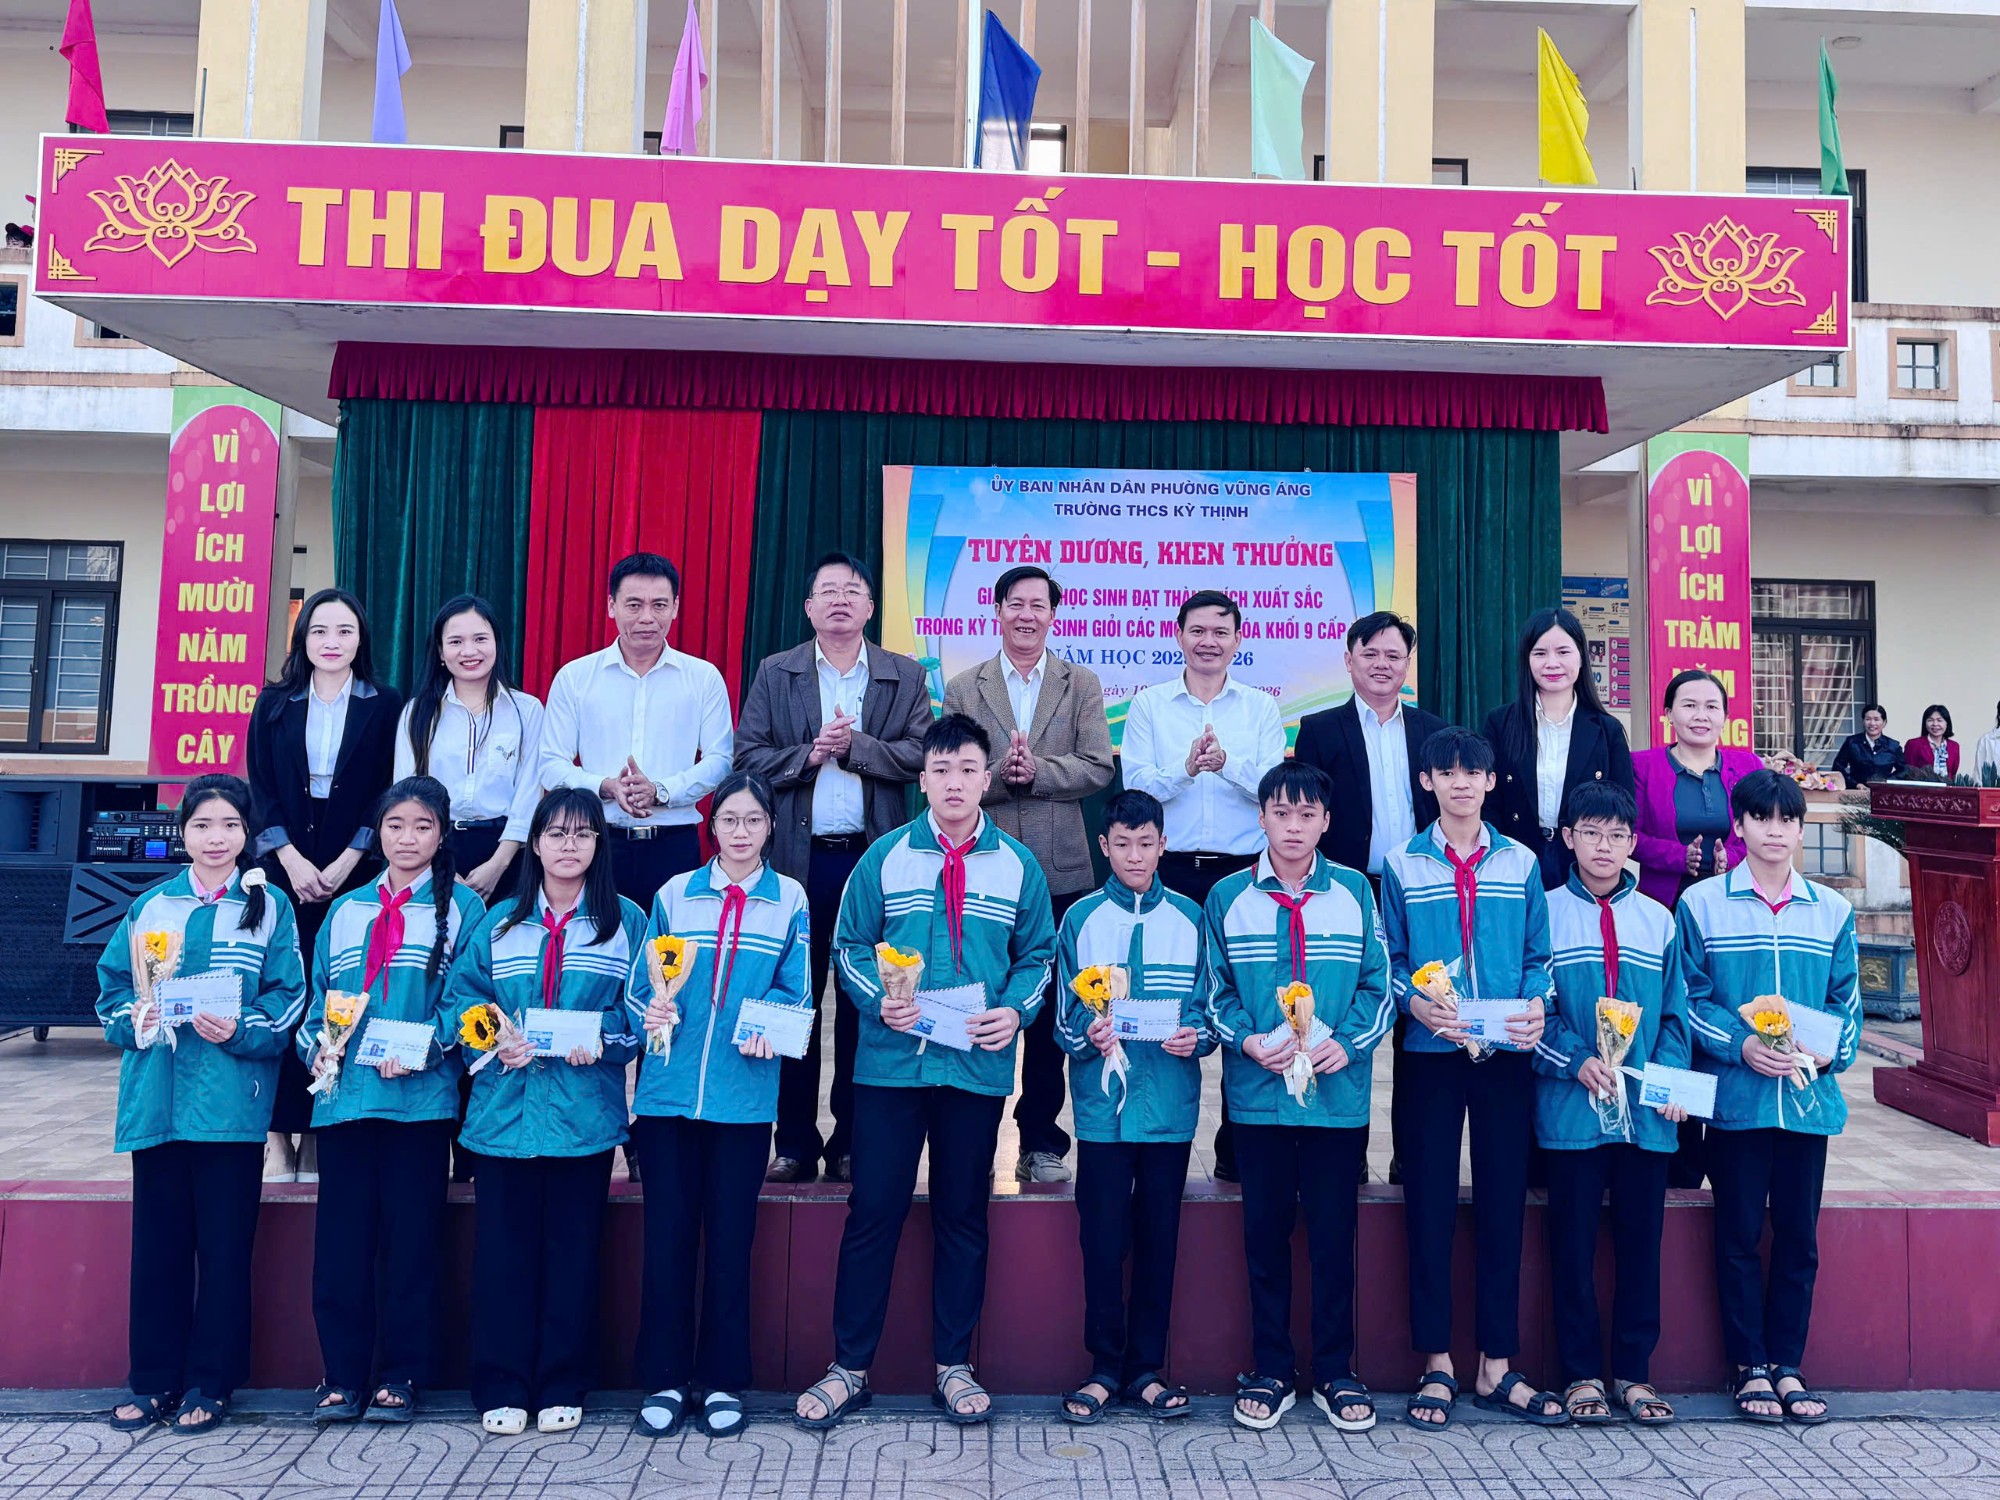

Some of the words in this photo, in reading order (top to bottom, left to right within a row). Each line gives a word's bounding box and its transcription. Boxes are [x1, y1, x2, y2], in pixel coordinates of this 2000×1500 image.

[286, 186, 447, 271] THI
[480, 194, 684, 281] ĐUA
[718, 204, 910, 303] DẠY
[940, 186, 1119, 297] TỐT
[1146, 251, 1181, 269] -
[1218, 223, 1412, 319] HỌC
[1442, 201, 1618, 312] TỐT
[212, 429, 240, 463] VÌ
[200, 481, 245, 519] LỢI
[991, 474, 1014, 492] ỦY
[1019, 480, 1053, 493] BAN
[1058, 479, 1105, 494] NHÂN
[1110, 480, 1145, 494] DÂN
[1151, 481, 1219, 495] PHƯỜNG
[1225, 481, 1271, 496] VŨNG
[1276, 482, 1311, 496] ÁNG
[1687, 471, 1713, 507] VÌ
[1054, 501, 1122, 516] TRƯỜNG
[1127, 505, 1168, 517] THCS
[1174, 503, 1195, 517] KỲ
[1201, 506, 1248, 521] THỊNH
[195, 526, 244, 562] ÍCH
[968, 534, 1051, 563] TUYÊN
[1060, 538, 1149, 568] DƯƠNG,
[1158, 541, 1225, 565] KHEN
[1233, 535, 1333, 566] THƯỞNG
[1680, 523, 1722, 559] LỢI
[178, 576, 254, 613] MƯỜI
[1093, 588, 1126, 606] SINH
[1132, 589, 1160, 610] ĐẠT
[1252, 585, 1290, 609] XUẤT
[1294, 587, 1323, 609] SẮC
[1679, 568, 1725, 602] ÍCH
[915, 618, 963, 636] TRONG
[968, 614, 986, 636] KỲ
[1052, 619, 1087, 637] SINH
[1092, 613, 1121, 637] GIỎI
[1126, 615, 1155, 637] CÁC
[1241, 617, 1261, 639] ÓA
[1266, 616, 1299, 640] KHỐI
[1304, 621, 1313, 640] 9
[1317, 616, 1347, 640] CẤP
[1664, 614, 1741, 651] TRĂM
[178, 627, 247, 663] NĂM
[1101, 649, 1146, 669] HỌC
[1152, 650, 1187, 665] 202
[161, 673, 257, 713] TRỒNG
[1103, 684, 1128, 697] gày
[176, 728, 235, 764] CÂY
[1659, 714, 1749, 748] TNG
